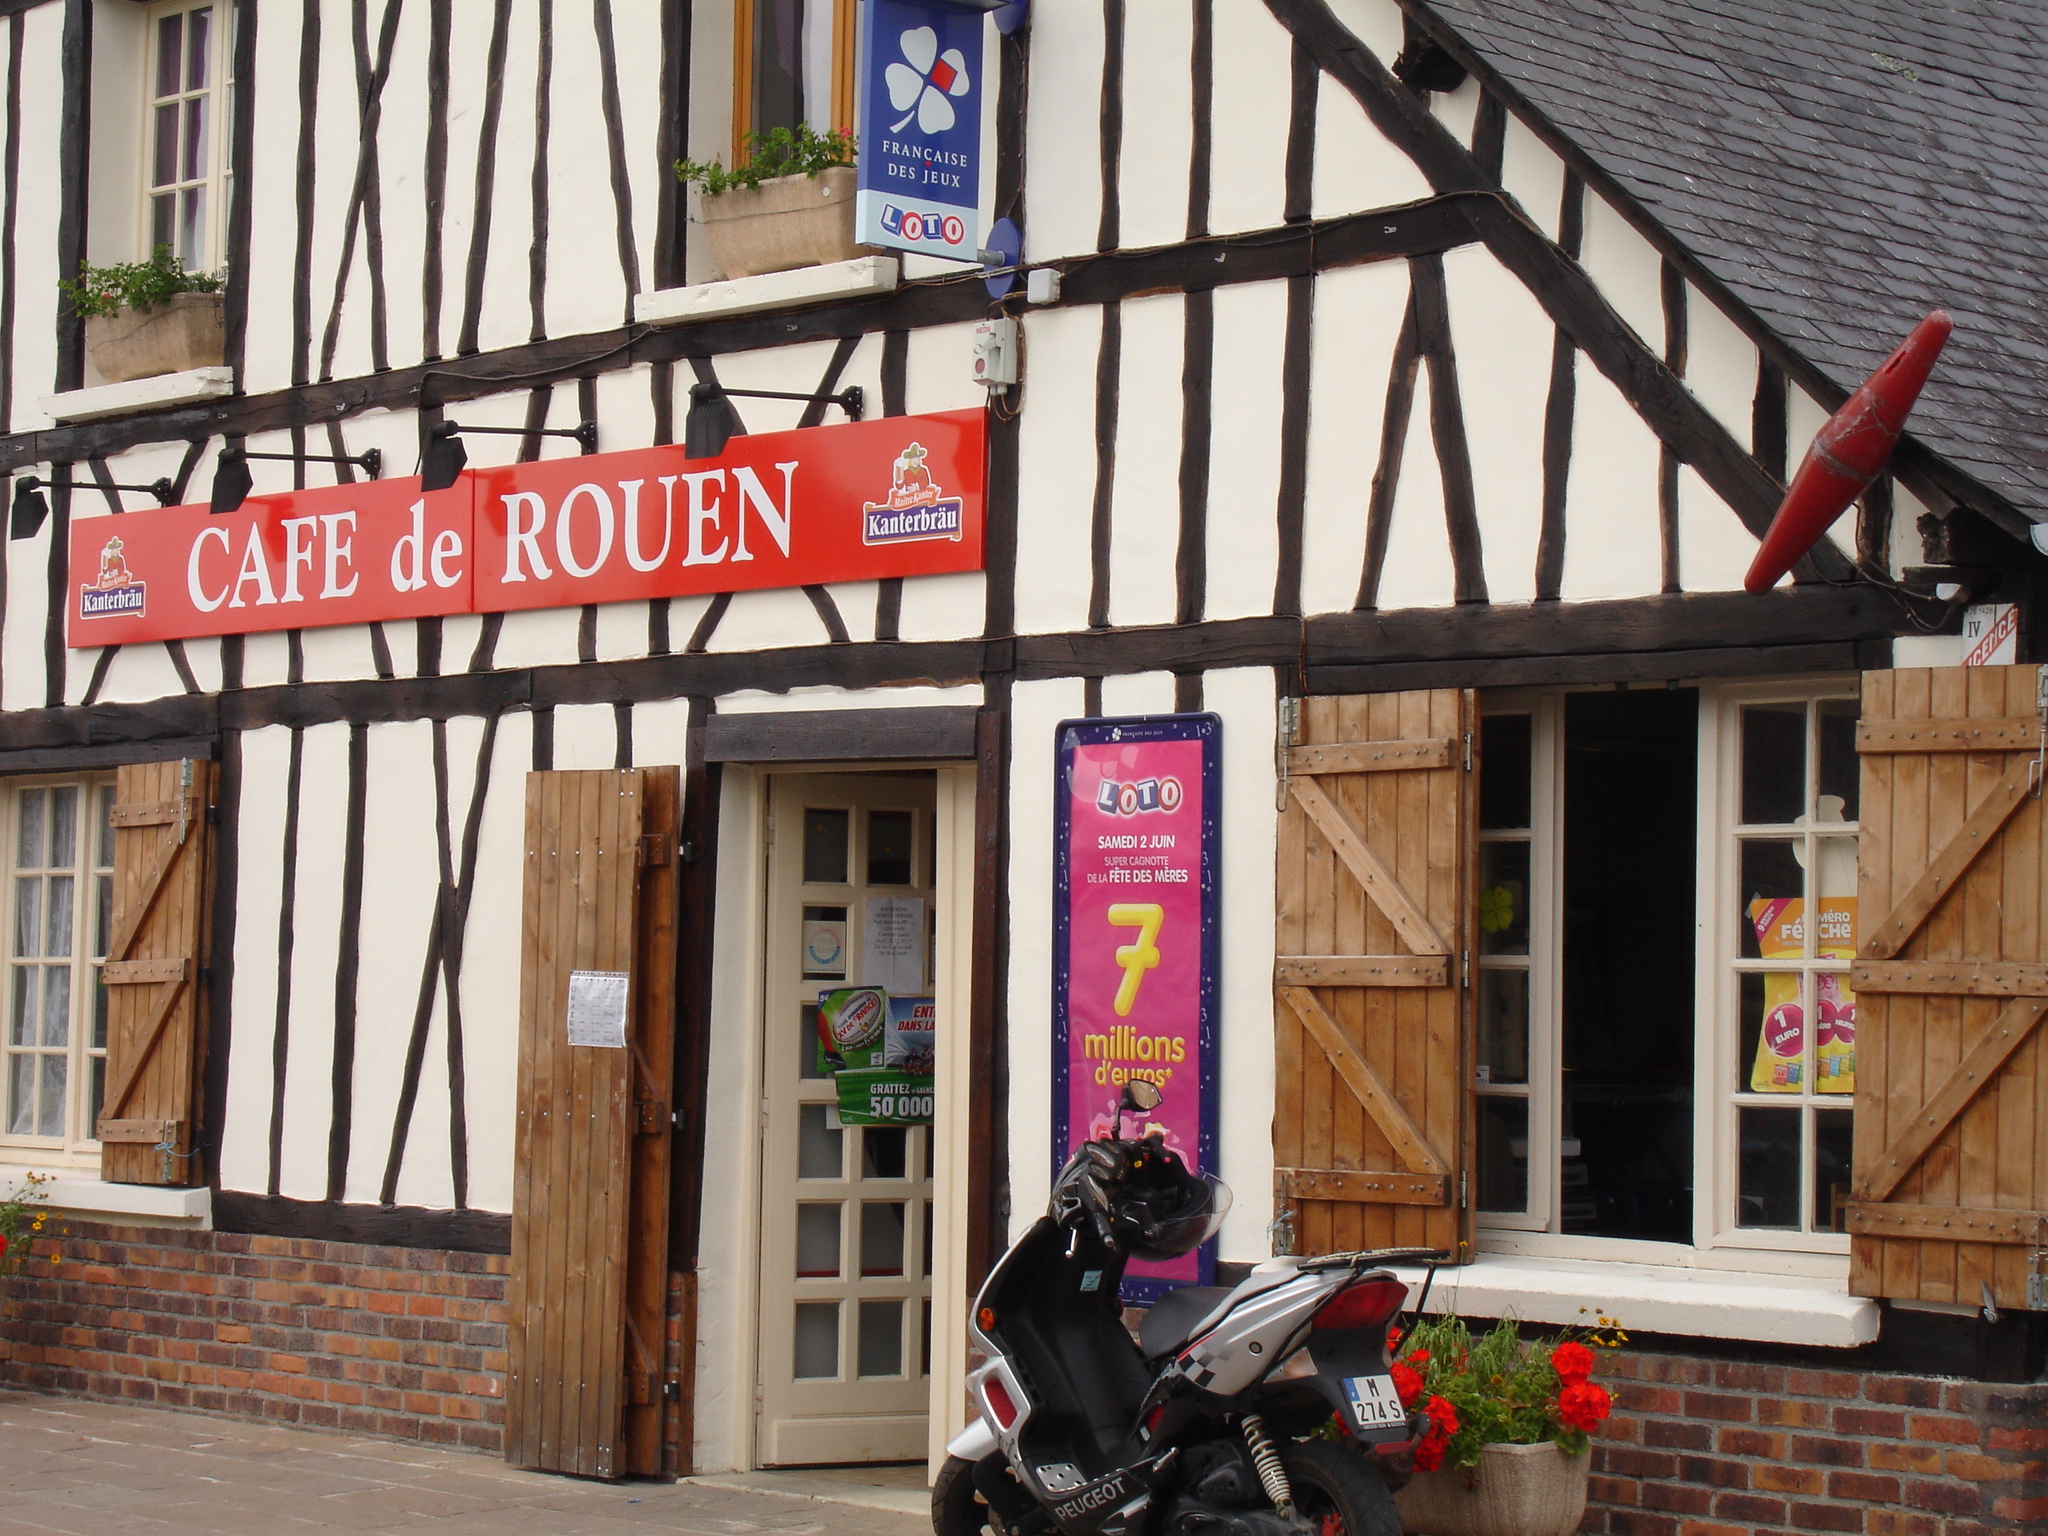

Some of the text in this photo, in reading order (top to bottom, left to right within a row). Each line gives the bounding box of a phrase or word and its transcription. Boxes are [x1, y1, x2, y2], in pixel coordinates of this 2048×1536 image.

[882, 140, 968, 168] FRANÇAISE
[888, 163, 961, 188] DES JEUX
[879, 203, 965, 246] LOTO
[868, 507, 957, 537] Kanterbräu
[187, 460, 799, 613] CAFE de ROUEN
[83, 589, 142, 613] Kanterbräu
[1968, 621, 1982, 638] IV
[1968, 608, 2018, 666] ICENCE
[1097, 779, 1181, 816] LOTO
[1098, 835, 1175, 849] SAMEDI 2 JUIN
[1104, 856, 1169, 866] SUPER CAGNOTTE
[1087, 866, 1188, 883] DE LA FÊTE DES MÈRES
[1802, 908, 1850, 922] MéRO
[1781, 917, 1851, 939] FéCHe
[1107, 903, 1164, 1017] 7
[913, 1005, 935, 1018] ENT
[1774, 1010, 1787, 1028] 1
[898, 1020, 935, 1031] DANS LA
[1775, 1027, 1800, 1044] EURO
[1084, 1025, 1186, 1063] millions
[870, 1083, 910, 1094] GRATTEZ
[869, 1096, 933, 1118] 50 000
[1366, 1378, 1380, 1397] M
[1356, 1400, 1401, 1422] 274 S
[1055, 1477, 1126, 1521] PEUGEOT
